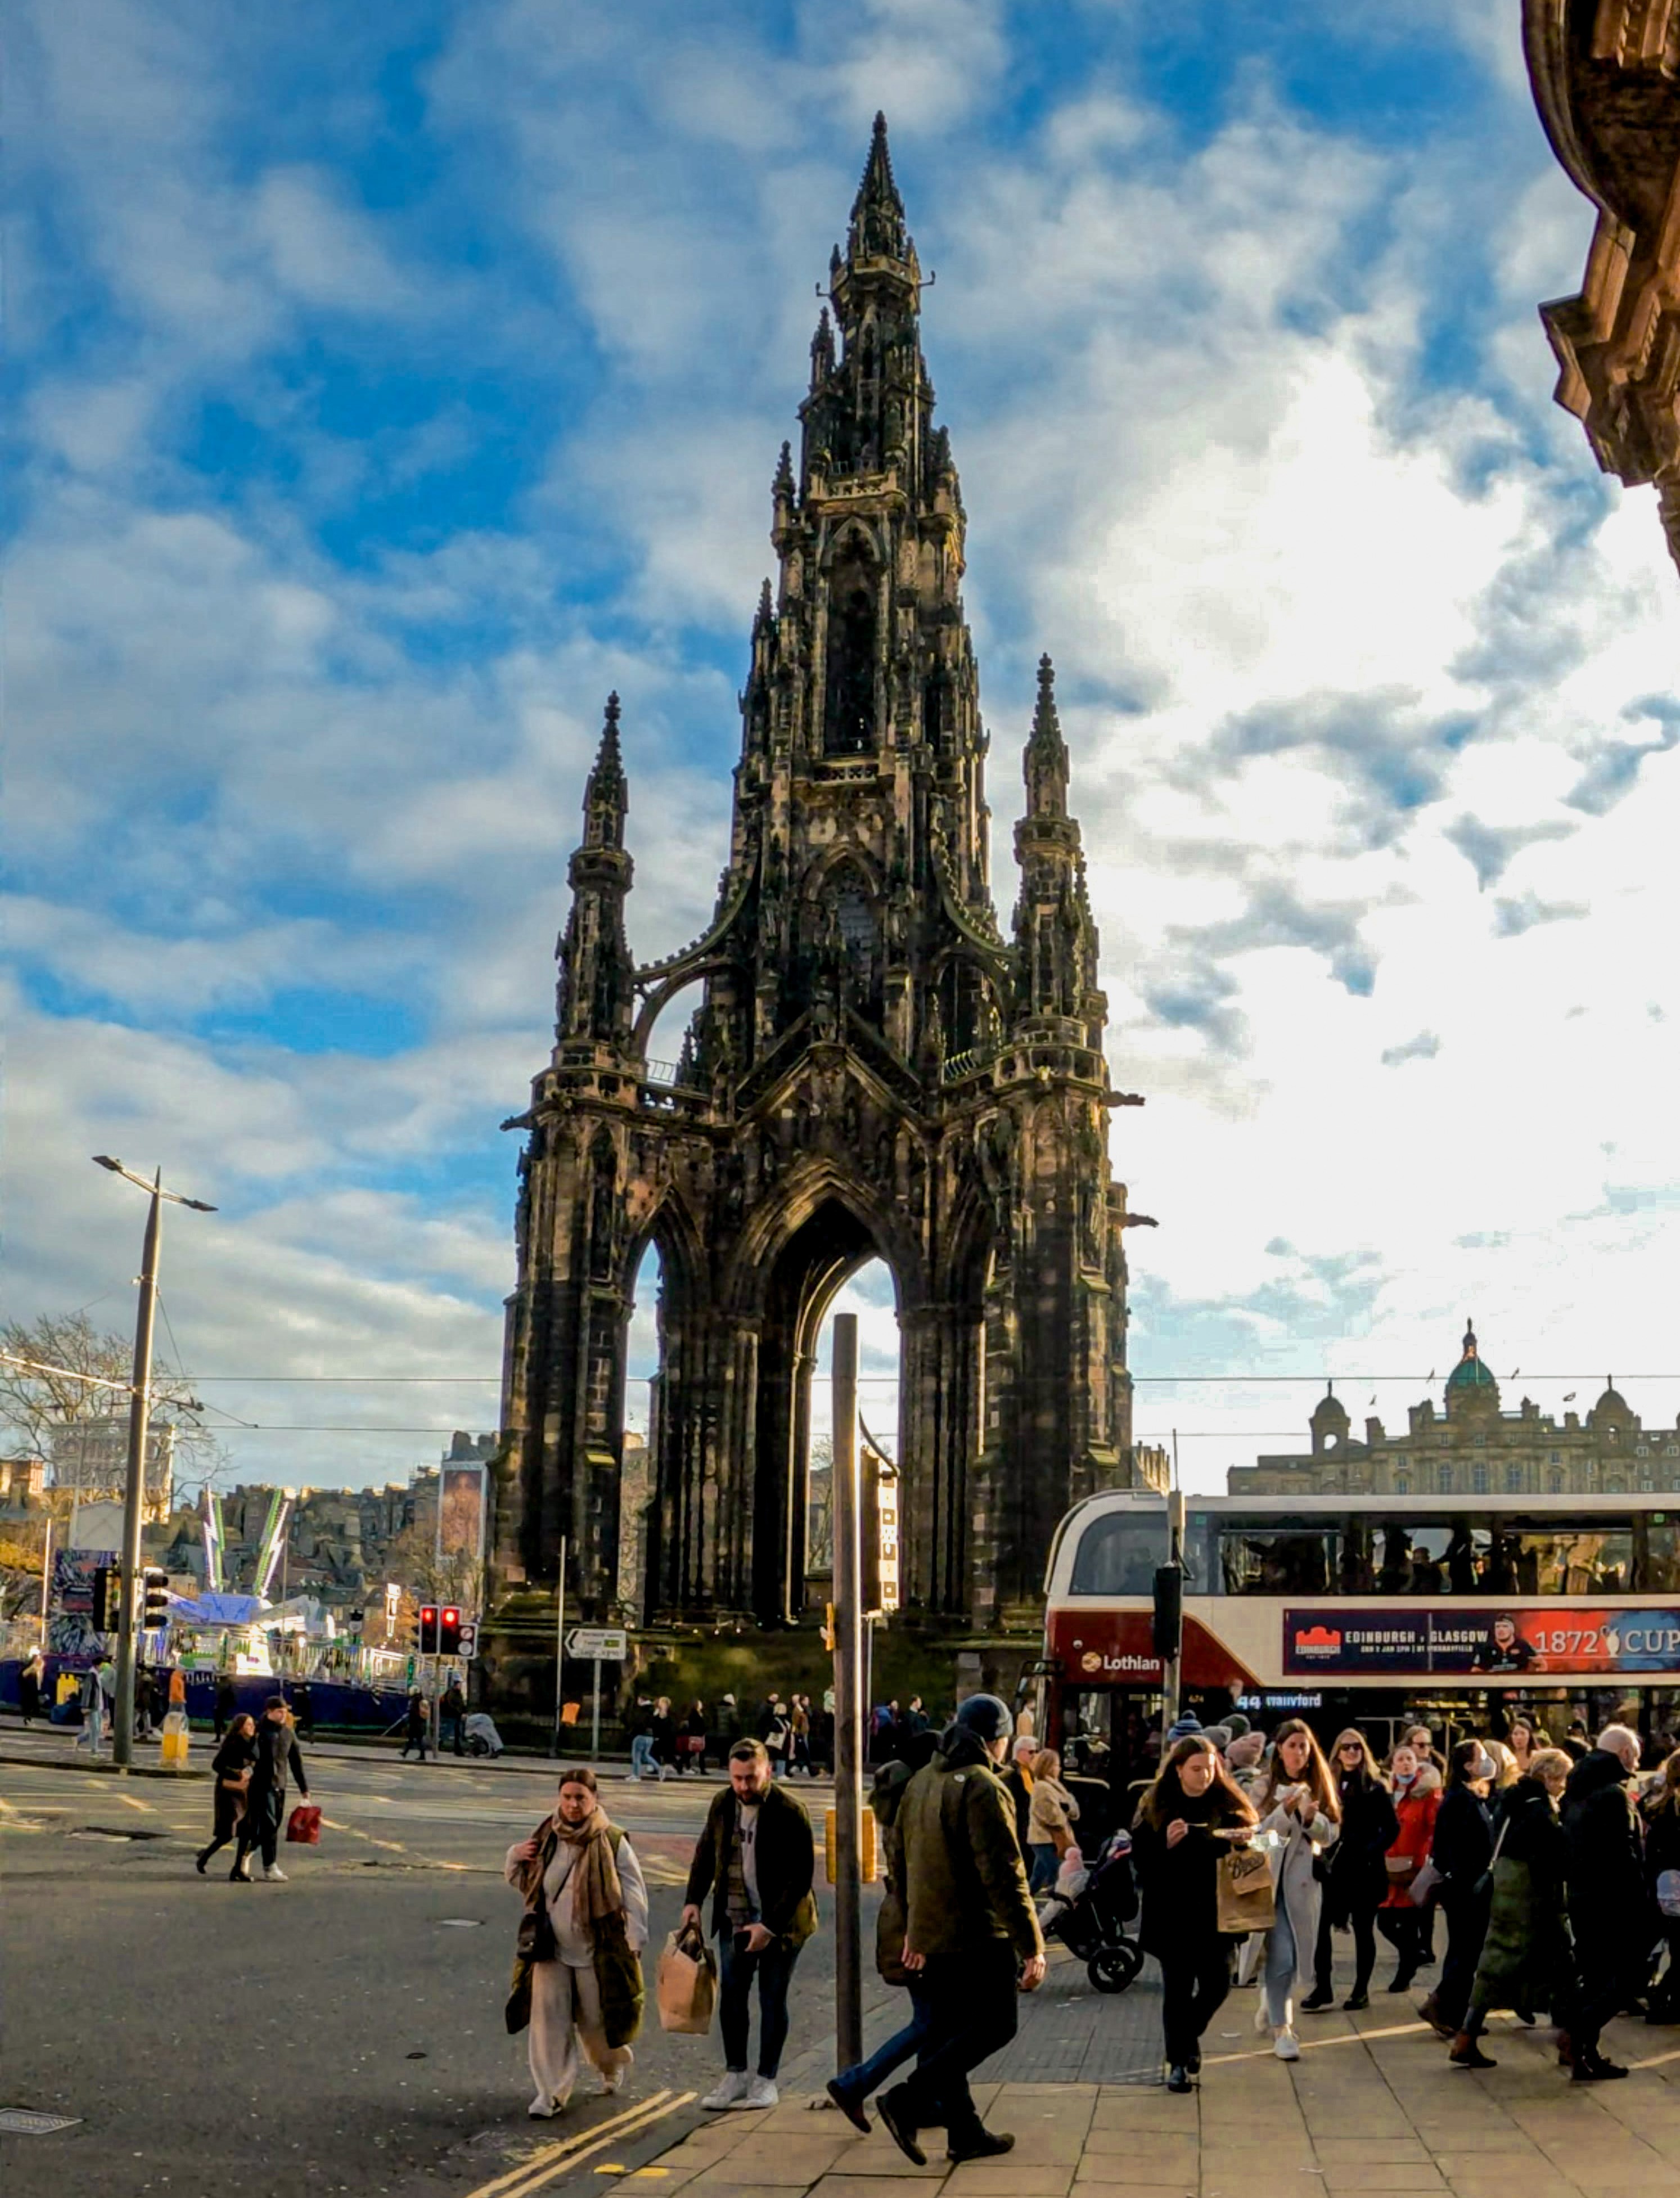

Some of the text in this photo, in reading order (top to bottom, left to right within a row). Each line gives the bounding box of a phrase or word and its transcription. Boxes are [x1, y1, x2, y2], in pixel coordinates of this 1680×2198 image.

[1345, 1631, 1416, 1643] EDINBURGH
[1430, 1630, 1489, 1643] GLASGOW
[1535, 1629, 1680, 1653] 1872 CUP
[1104, 1655, 1160, 1670] Lothian
